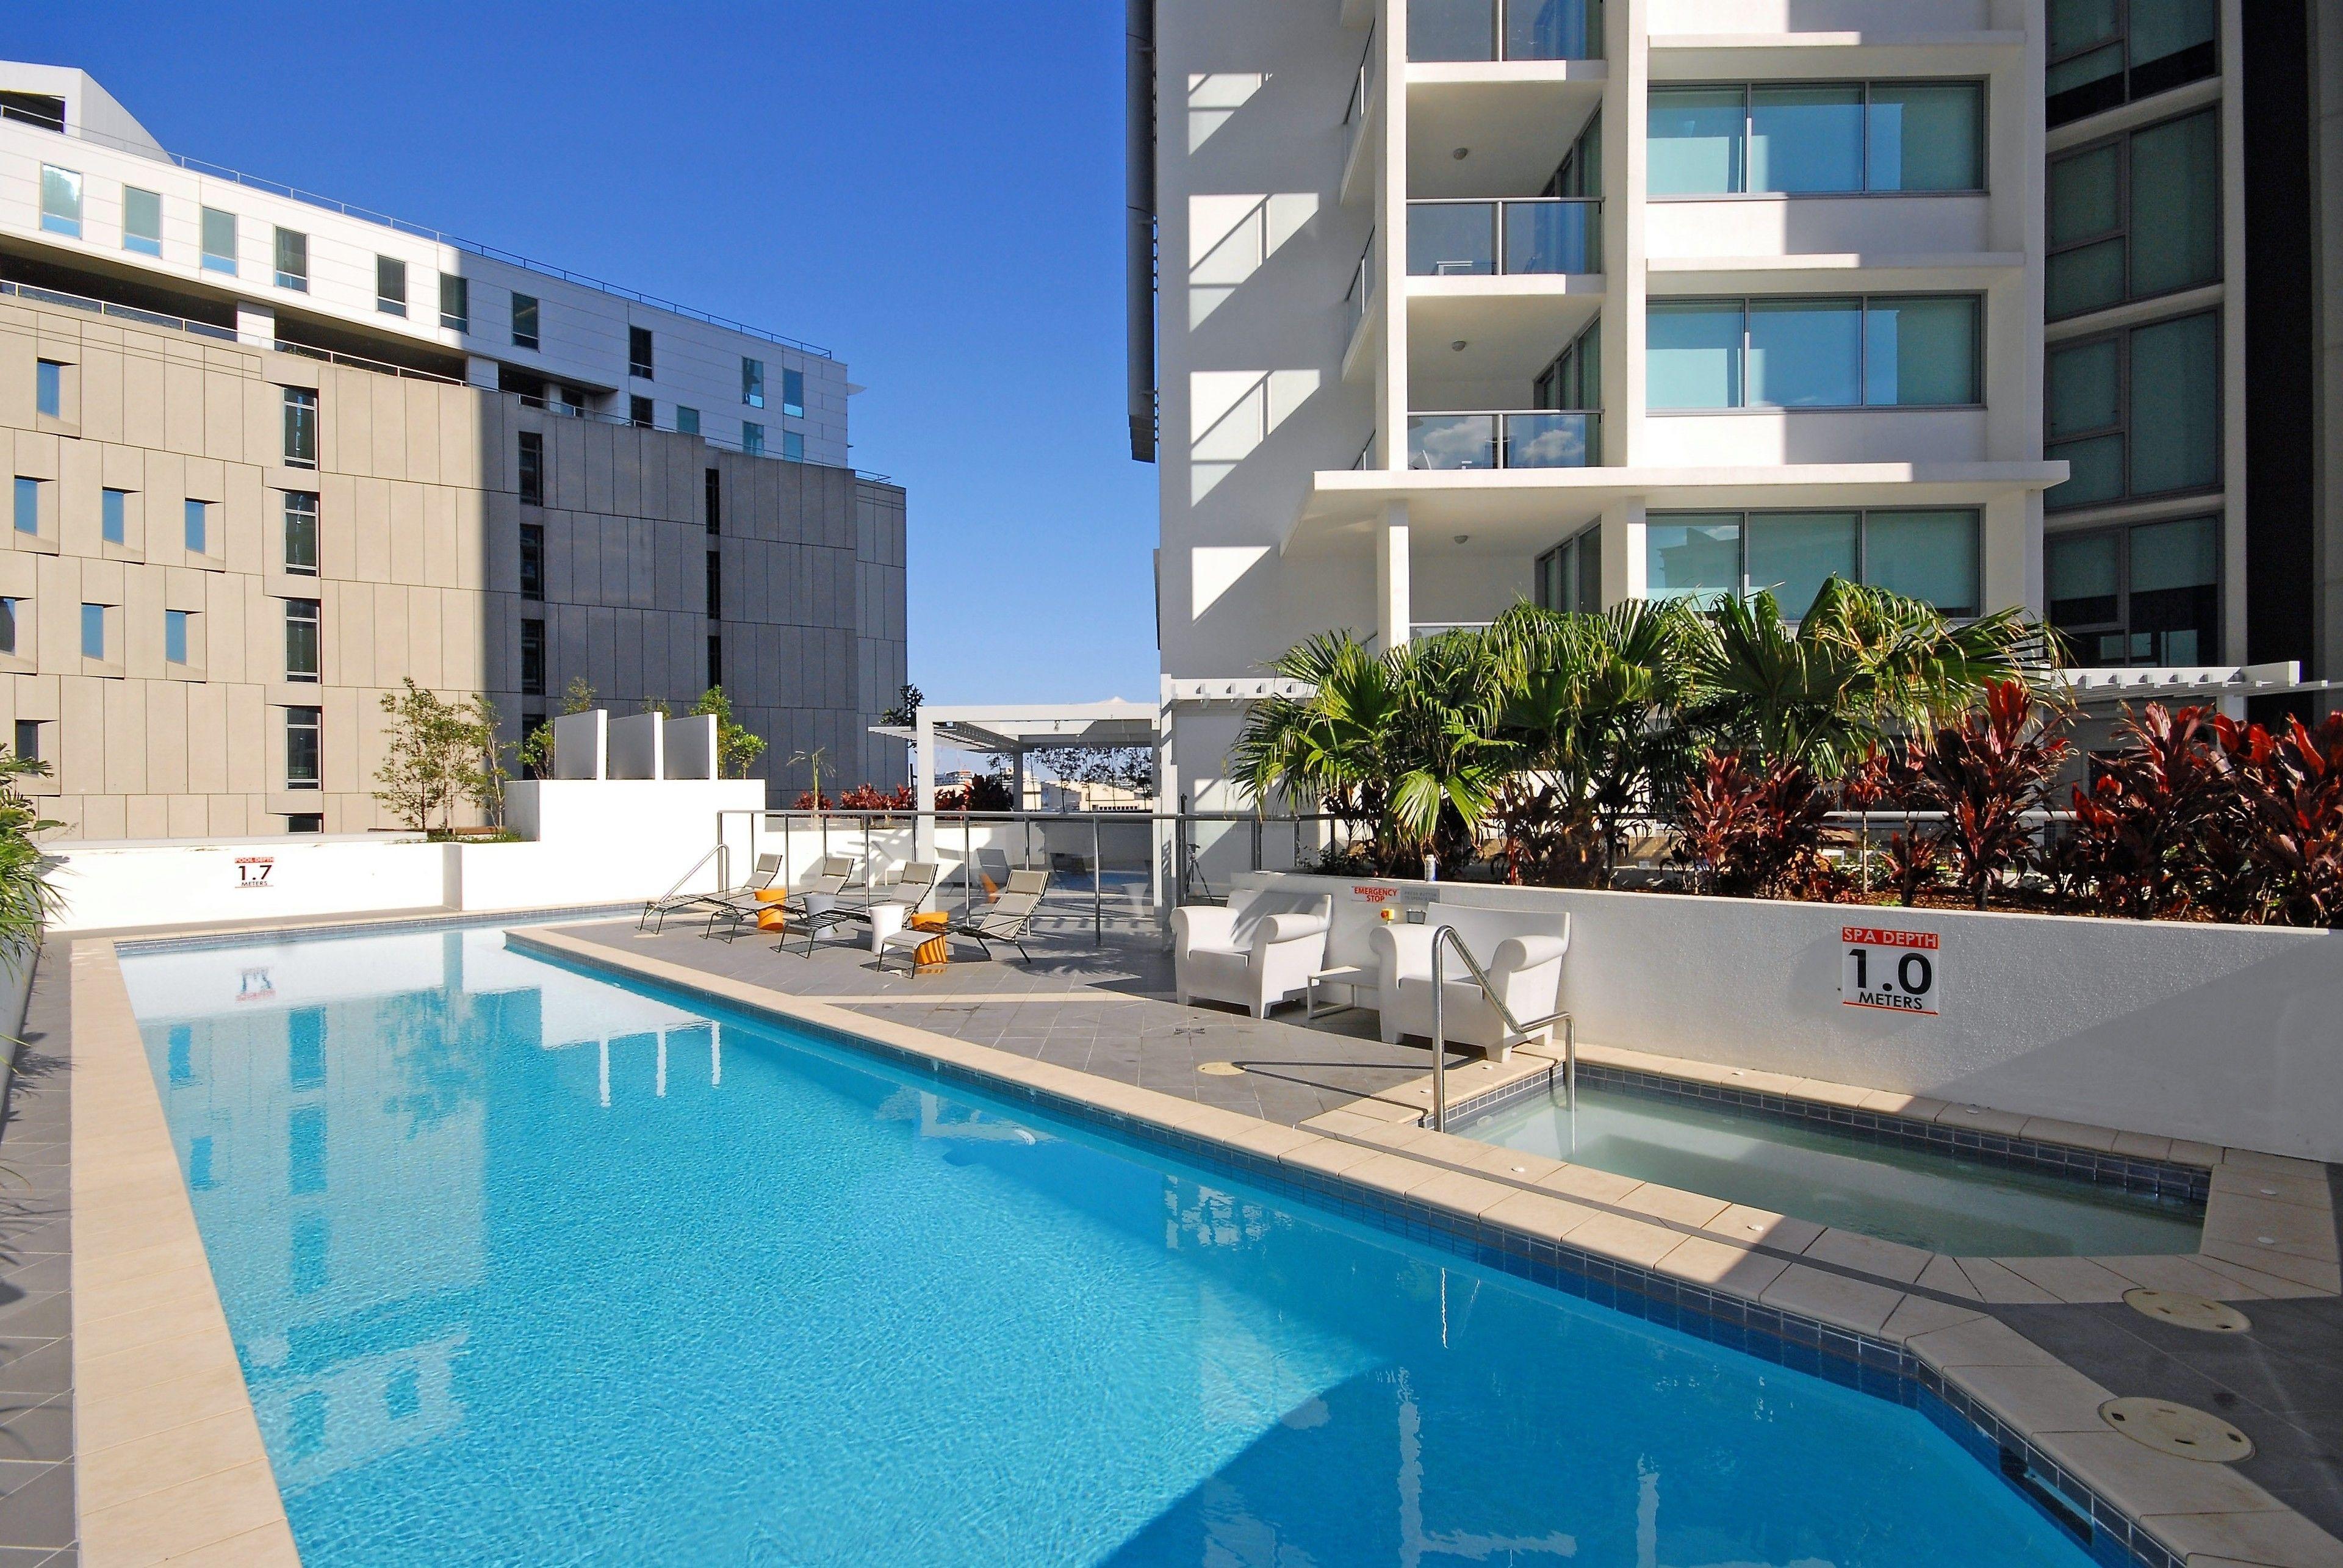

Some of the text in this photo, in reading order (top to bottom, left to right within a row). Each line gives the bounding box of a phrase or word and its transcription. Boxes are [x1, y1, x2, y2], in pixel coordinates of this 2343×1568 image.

[239, 865, 272, 880] 1.7
[1354, 887, 1397, 896] EMERGENCY
[1844, 928, 1937, 948] SPA DEPTH
[1849, 949, 1932, 995] 1.0
[1859, 992, 1923, 1010] METERS
